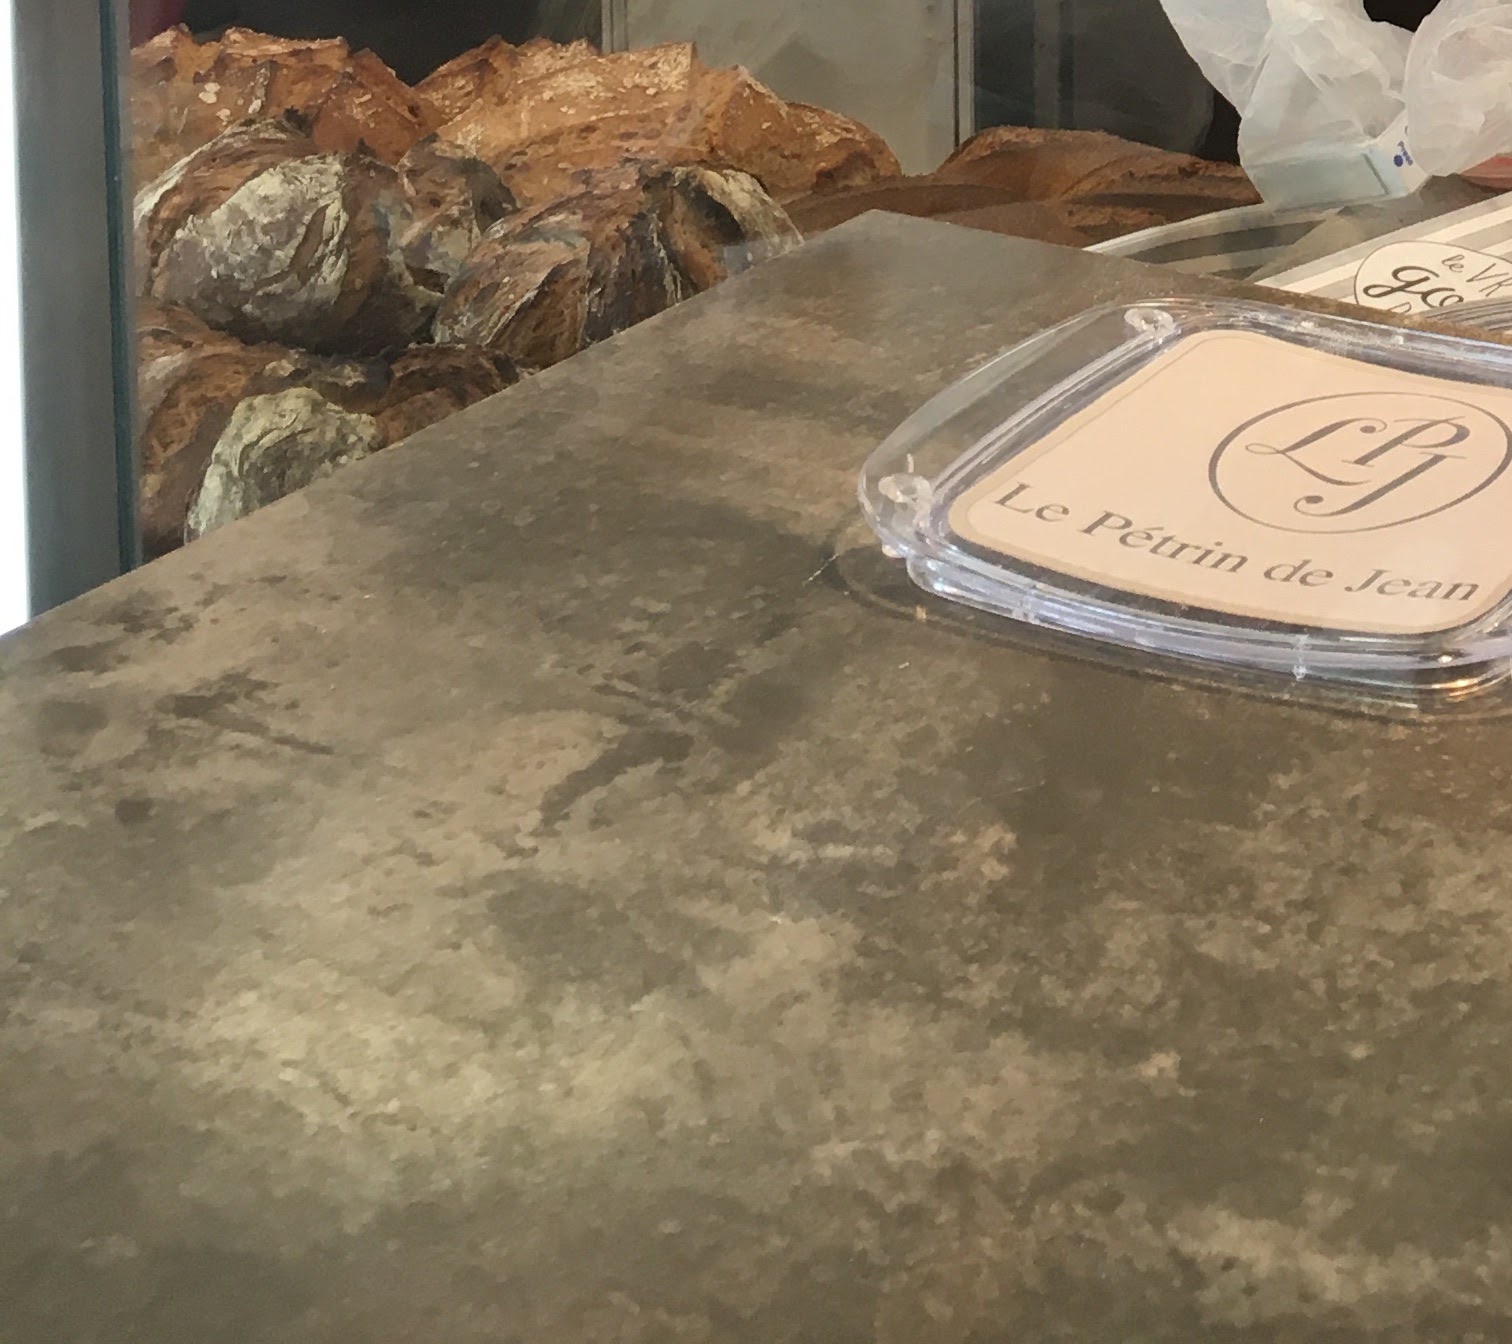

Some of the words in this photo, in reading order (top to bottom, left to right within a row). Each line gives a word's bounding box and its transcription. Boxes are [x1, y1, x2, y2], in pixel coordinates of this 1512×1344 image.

[994, 480, 1070, 524] Le
[1076, 508, 1247, 575] Pétrin
[1264, 557, 1334, 590] de
[1345, 566, 1482, 606] Jean
